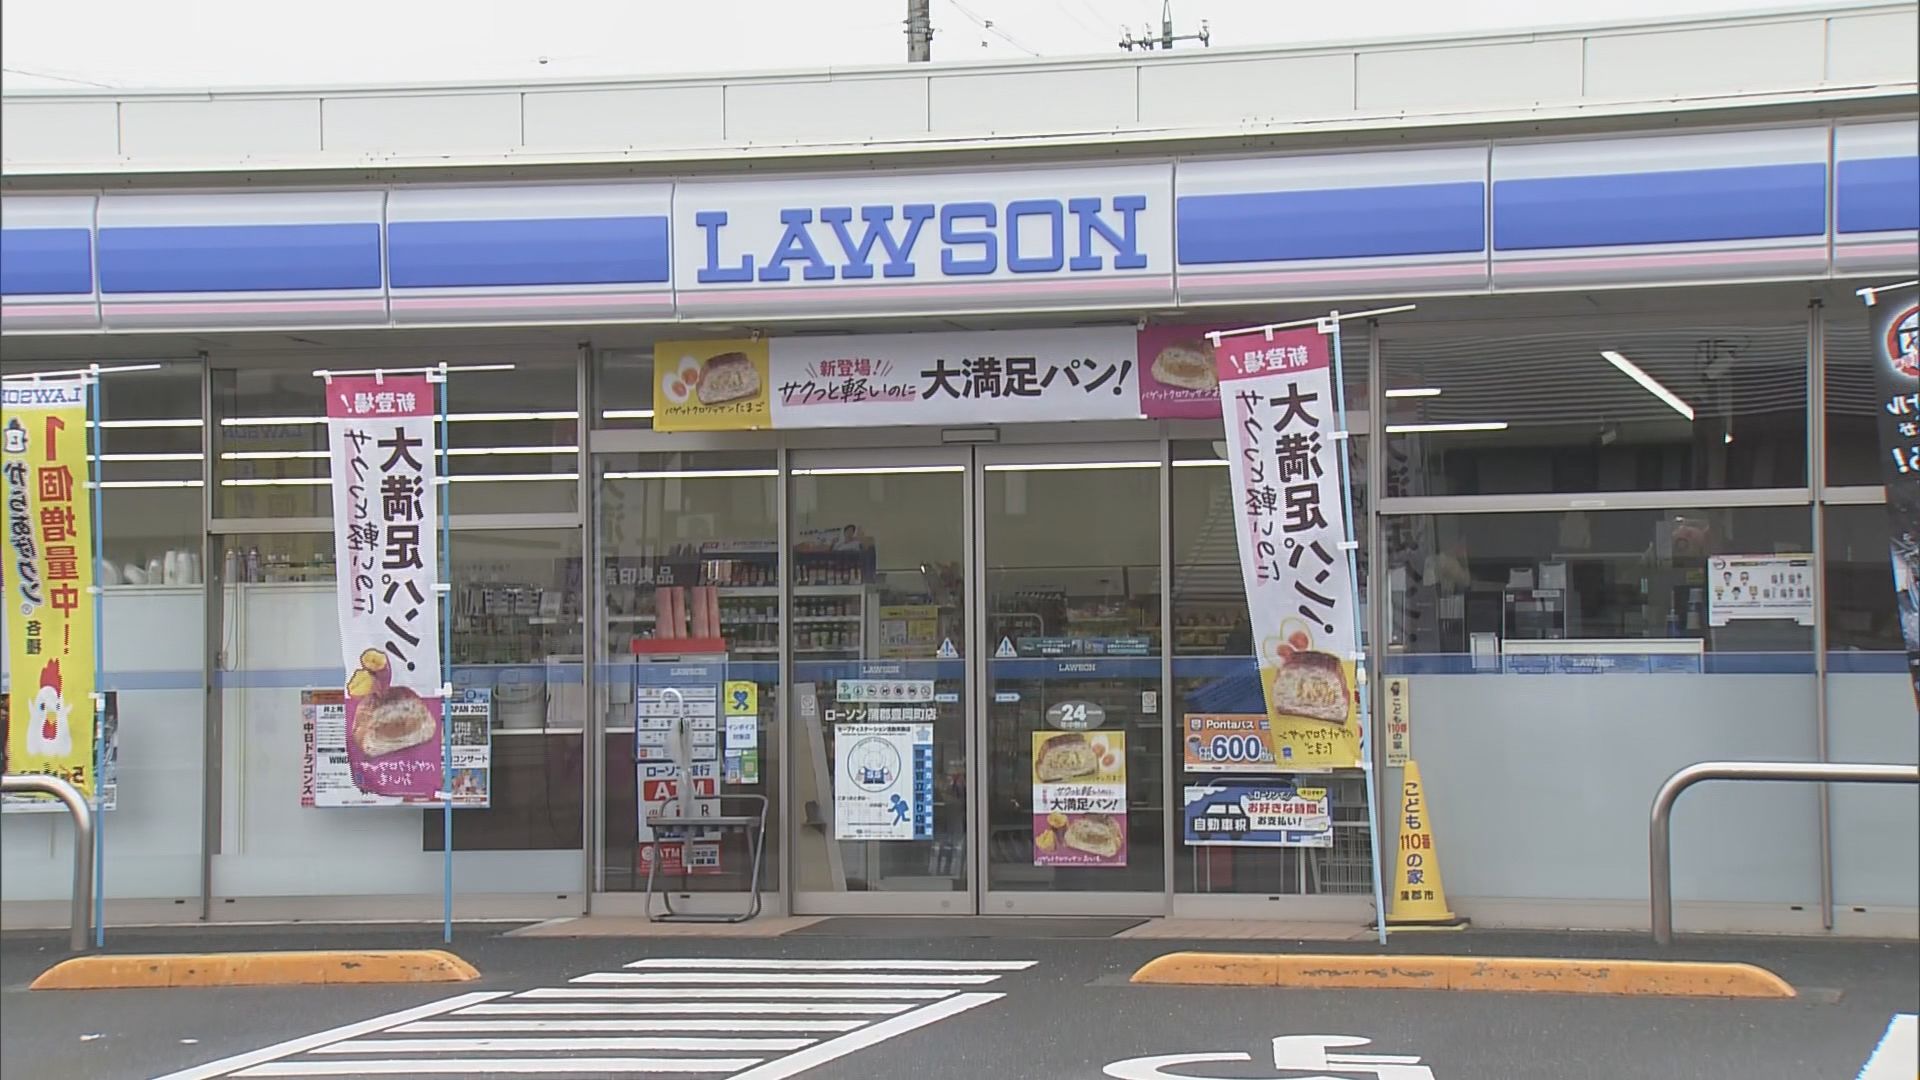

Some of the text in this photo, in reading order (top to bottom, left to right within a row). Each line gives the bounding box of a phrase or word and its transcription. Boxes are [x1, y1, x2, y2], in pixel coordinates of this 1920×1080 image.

[696, 195, 1147, 283] LAWSON
[819, 358, 881, 377] 新登場!
[920, 357, 1132, 399] 大満足パン!
[778, 377, 917, 404] サクっと軽いのに
[1062, 704, 1087, 721] 24
[1206, 719, 1255, 729] Pontaパス
[1211, 735, 1262, 762] 600
[303, 722, 314, 795] 中日ドラゴンズ
[1050, 797, 1118, 811] 大満足パン!
[1247, 803, 1326, 815] お好きな時間に
[1194, 818, 1247, 833] 自動車税
